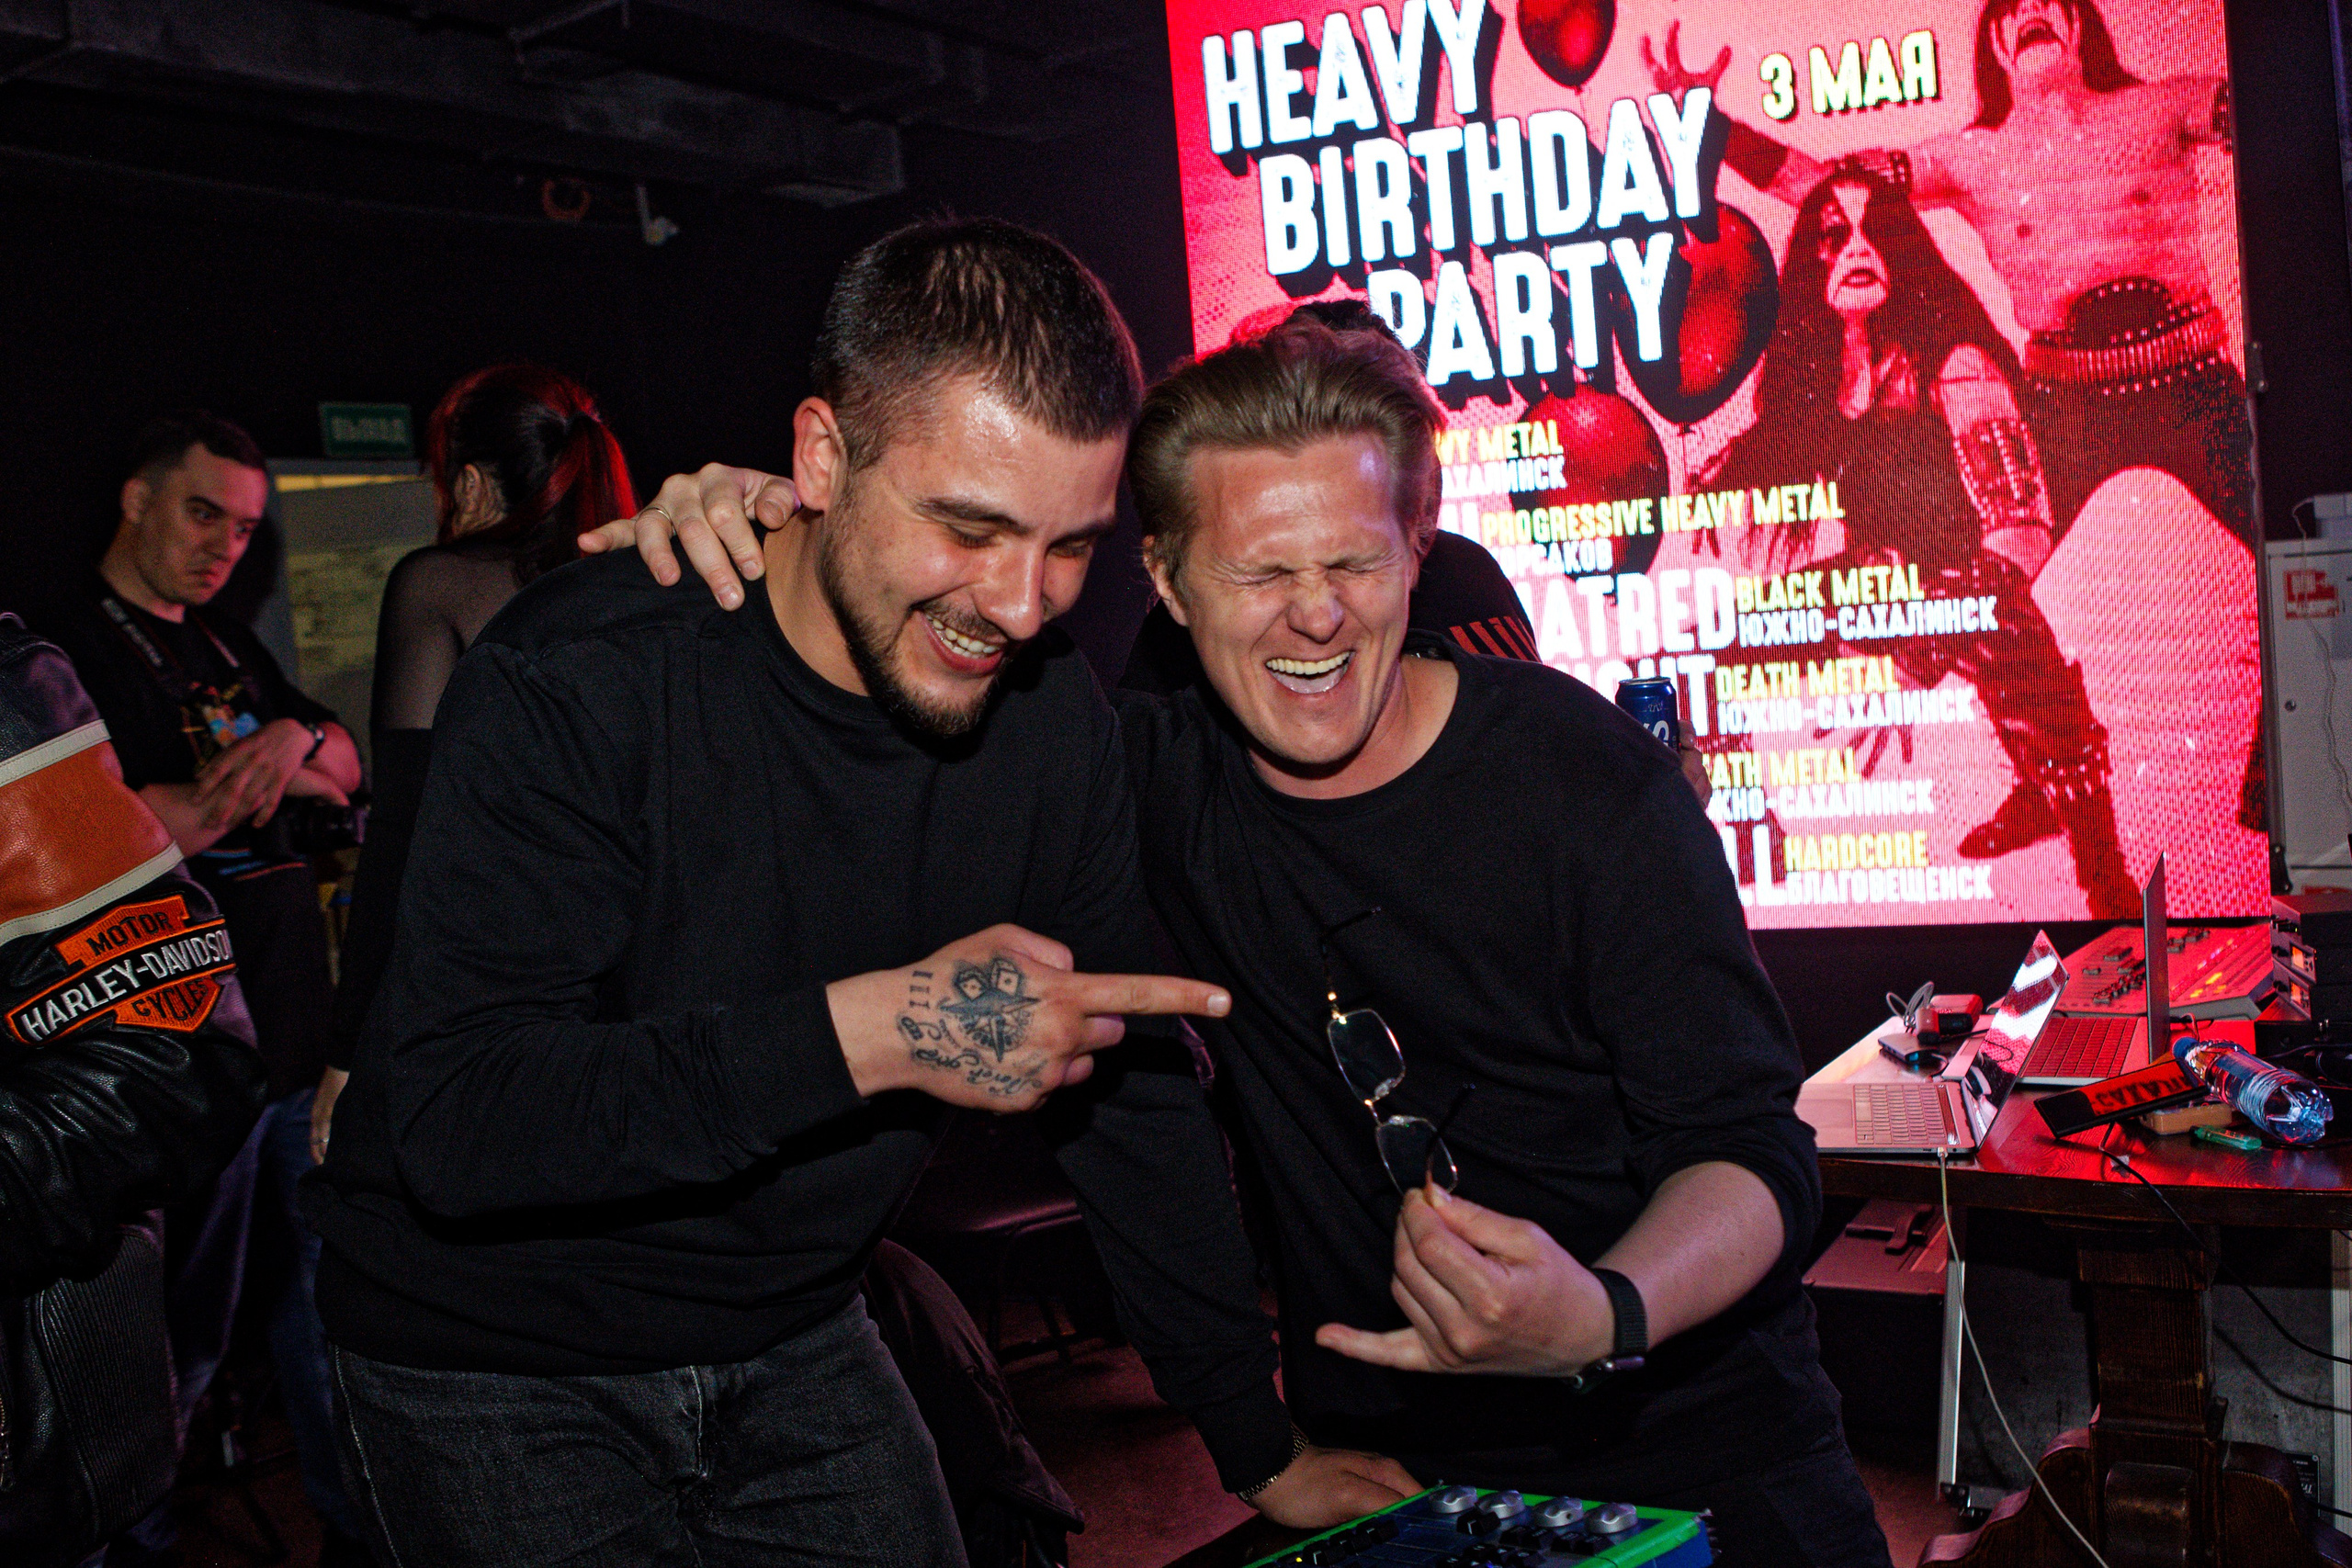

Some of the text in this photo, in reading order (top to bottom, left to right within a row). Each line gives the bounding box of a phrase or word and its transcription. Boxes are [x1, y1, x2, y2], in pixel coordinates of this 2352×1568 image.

[1202, 0, 1486, 154] HEAVY
[1760, 29, 1938, 120] 3 МАЯ
[1260, 87, 1713, 276] BIRTHDAY
[1367, 231, 1674, 387] PARTY
[1477, 420, 1564, 461] METAL
[1442, 456, 1567, 498] АХАЛИНСК
[1481, 498, 1655, 548] PROGRESSIVE
[1660, 489, 1746, 534] HEAVY
[1752, 480, 1846, 525] METAL
[1735, 562, 1926, 614] BLACK METAL
[1737, 595, 1999, 648] ЮЖНО-САХАЛИНСК
[1714, 660, 1800, 703] DEATH
[1806, 654, 1901, 697] METAL
[1717, 686, 1975, 736] ЮЖНО-САХАЛИНСК
[1702, 747, 1860, 790] ATH METAL
[1706, 779, 1935, 822] ЖНО-САХАЛИНСК
[1784, 830, 1928, 872] HARDCORE
[1784, 865, 1993, 905] БЛАГОВЕЩЕНСК
[85, 911, 173, 956] MOTOR
[131, 979, 209, 1021] CYCLES
